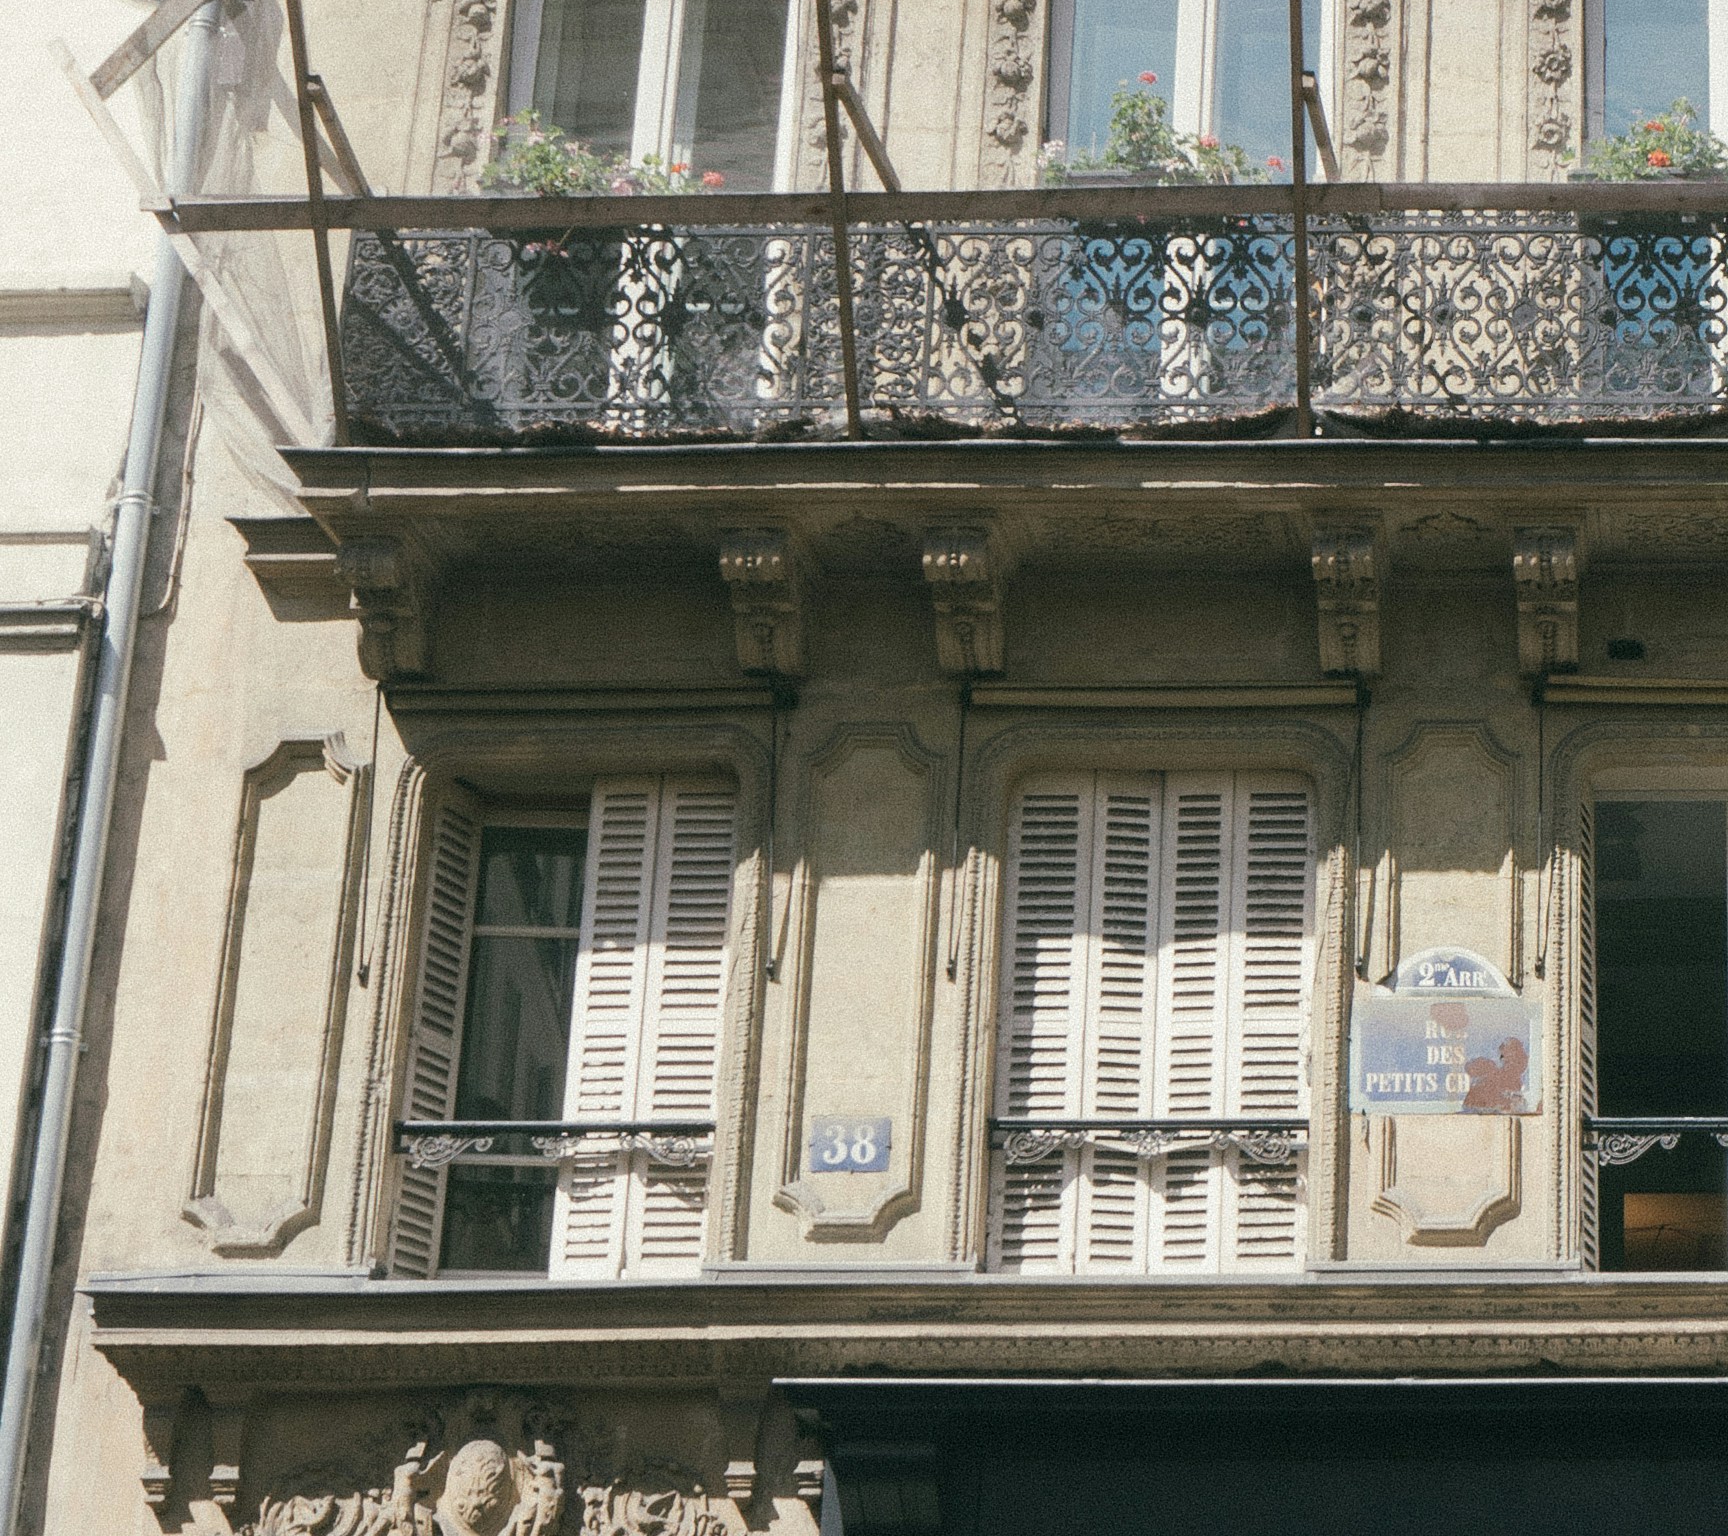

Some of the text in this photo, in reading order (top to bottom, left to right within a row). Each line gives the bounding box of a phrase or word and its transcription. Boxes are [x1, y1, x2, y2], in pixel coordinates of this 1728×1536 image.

[1426, 1045, 1466, 1065] DES
[1365, 1072, 1438, 1093] PETITS
[822, 1124, 877, 1165] 38
